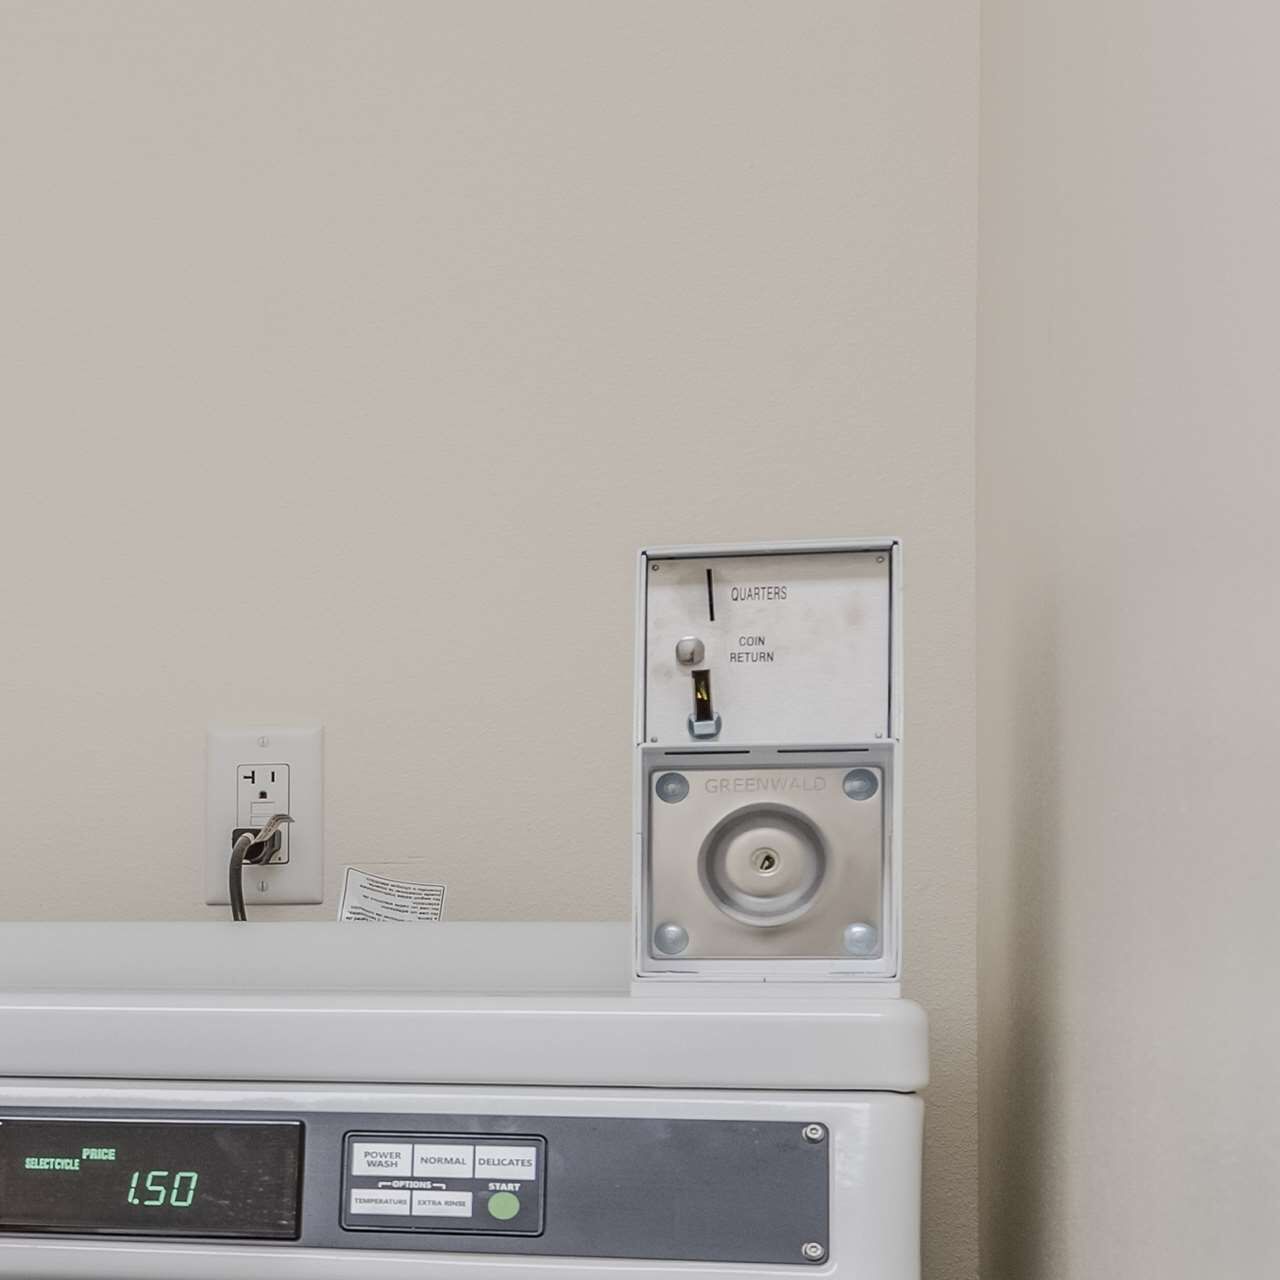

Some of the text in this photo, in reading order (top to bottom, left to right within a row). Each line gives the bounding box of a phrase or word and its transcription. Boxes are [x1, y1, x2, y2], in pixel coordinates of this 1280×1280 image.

[730, 586, 788, 601] QUARTERS
[738, 635, 766, 648] COIN
[729, 651, 775, 664] RETURN
[704, 776, 827, 793] GREENWALD
[82, 1148, 116, 1161] PRICE
[363, 1151, 402, 1160] POWER
[25, 1157, 80, 1171] SELECT CYCLE
[366, 1159, 399, 1168] WASH
[420, 1156, 467, 1166] NORMAL
[478, 1157, 533, 1167] DELICATES
[126, 1170, 199, 1207] 1.50
[391, 1180, 433, 1189] OPTIONS
[488, 1182, 521, 1192] START
[354, 1197, 408, 1206] TEMPERATURE
[417, 1199, 467, 1208] EXTRA RINSE
